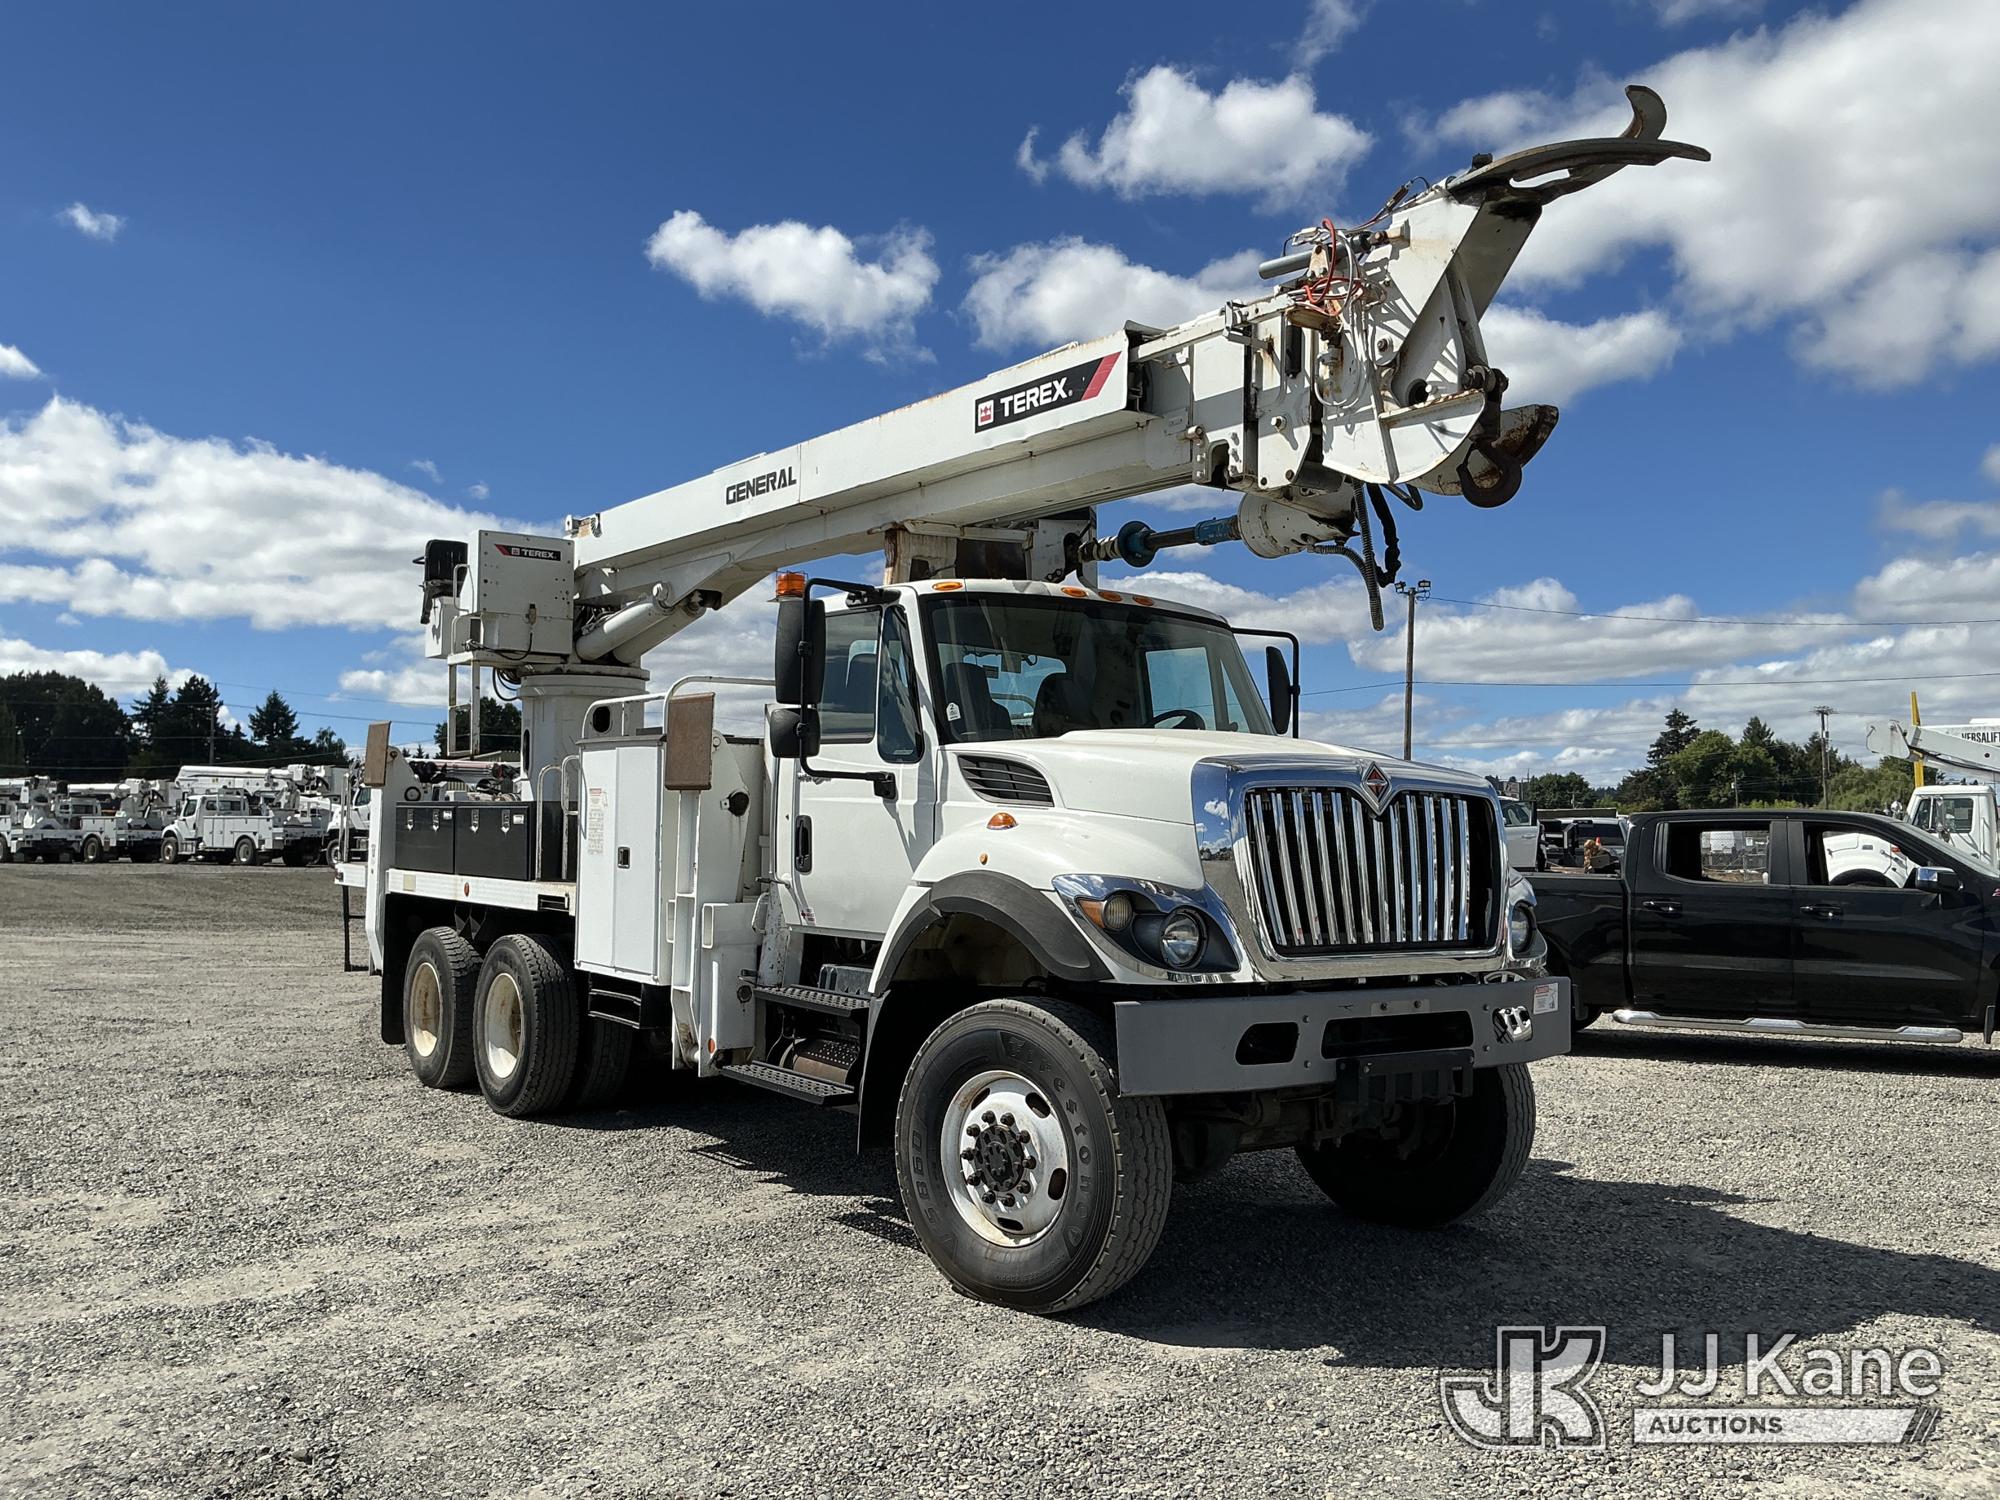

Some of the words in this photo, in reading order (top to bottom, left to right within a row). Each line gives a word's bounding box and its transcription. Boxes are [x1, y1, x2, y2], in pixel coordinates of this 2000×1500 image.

[1000, 377, 1068, 417] TEREX
[726, 466, 797, 505] GENERAL
[521, 548, 555, 559] TEREX
